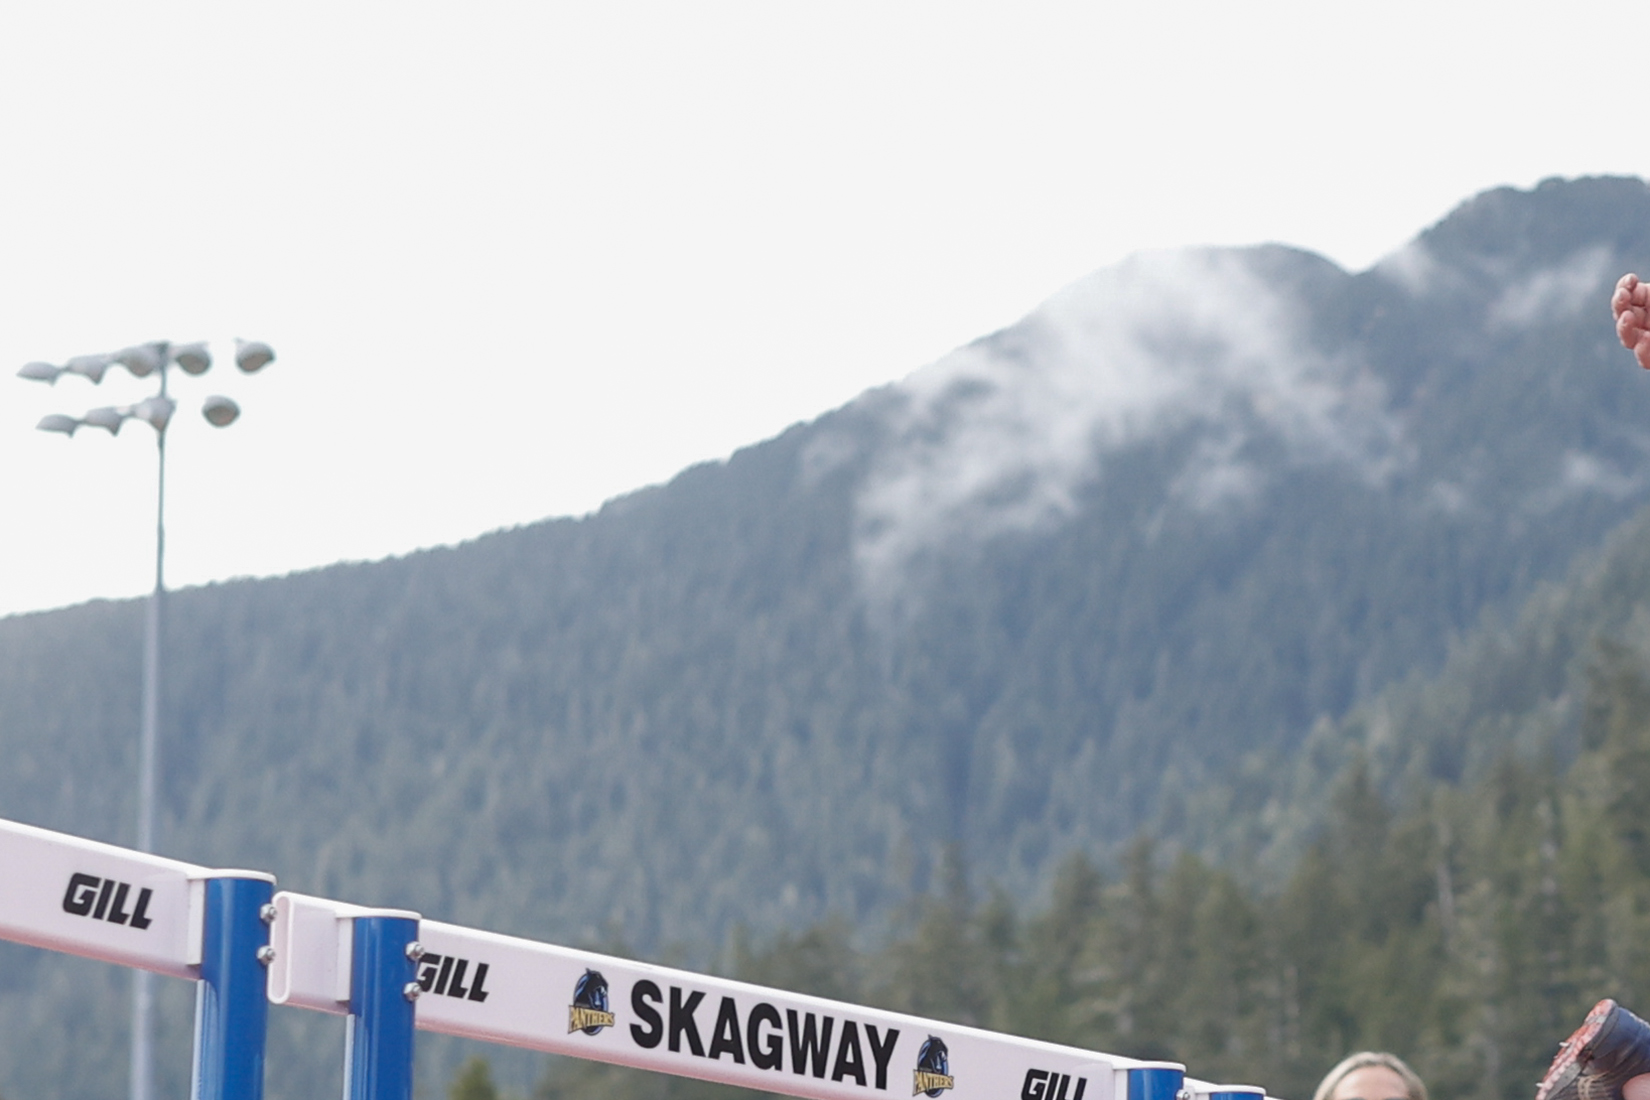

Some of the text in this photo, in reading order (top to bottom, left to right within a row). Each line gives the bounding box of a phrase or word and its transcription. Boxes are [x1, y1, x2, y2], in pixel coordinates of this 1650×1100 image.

[63, 872, 153, 930] GILL
[416, 952, 490, 1003] GILL
[629, 979, 900, 1090] SKAGWAY
